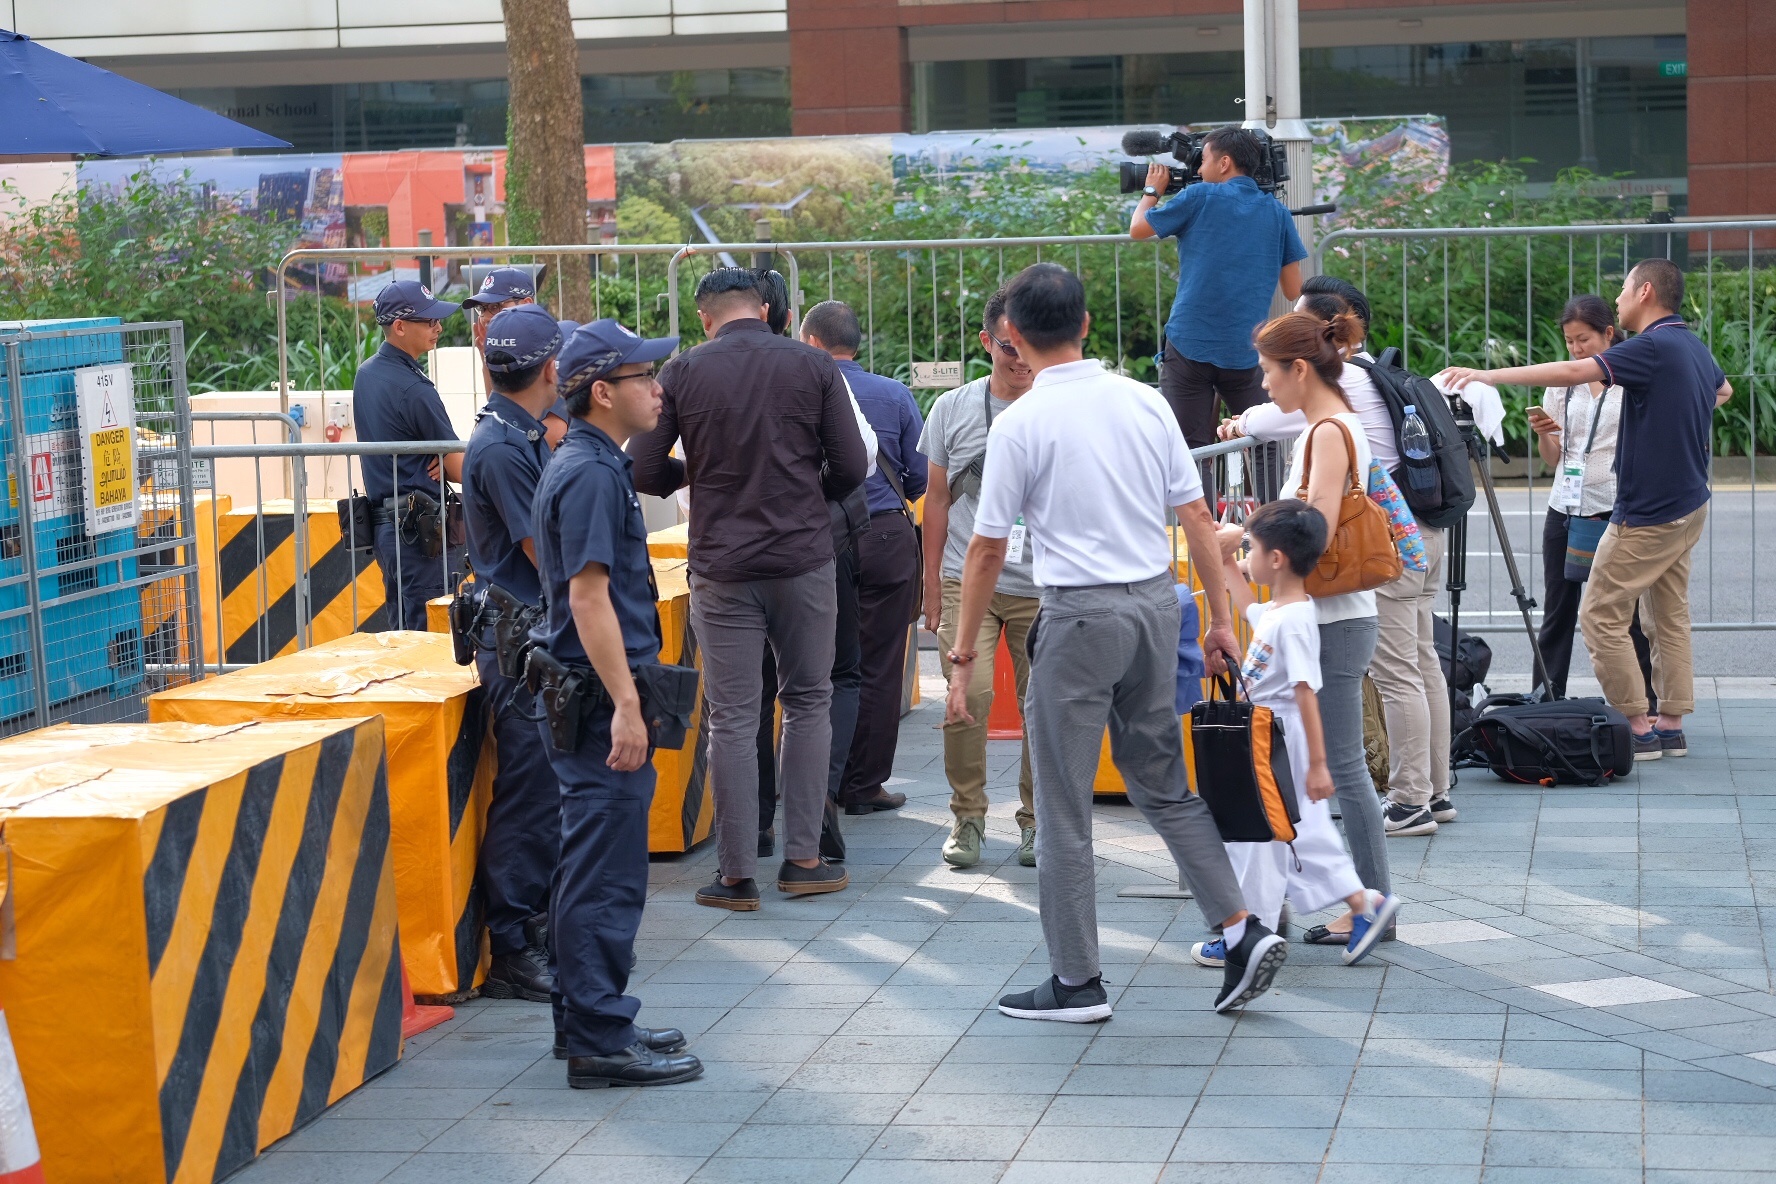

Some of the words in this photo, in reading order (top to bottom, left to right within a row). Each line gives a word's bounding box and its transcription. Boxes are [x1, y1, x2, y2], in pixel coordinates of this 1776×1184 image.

[1665, 63, 1686, 75] EXIT
[265, 102, 318, 116] School
[486, 338, 517, 347] POLICE
[96, 373, 114, 387] 415V
[95, 430, 125, 447] DANGER
[100, 487, 127, 505] BAHAYA
